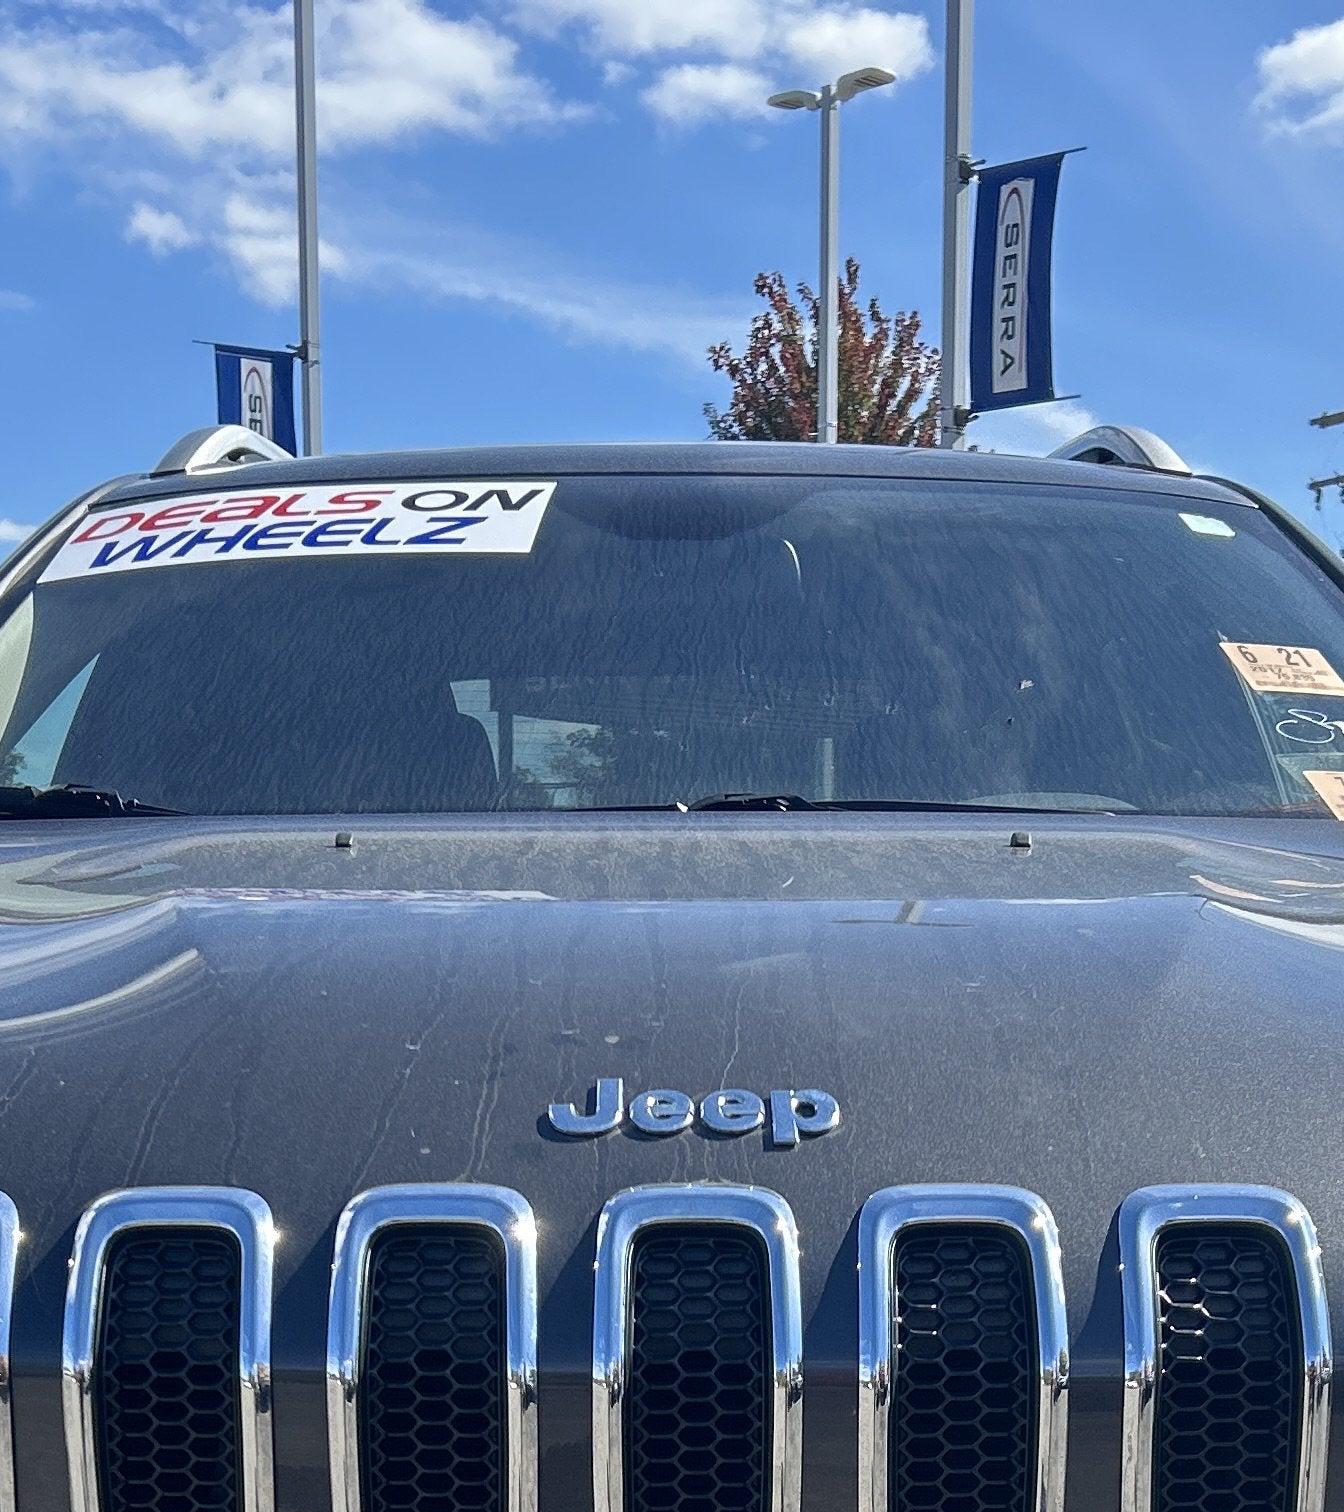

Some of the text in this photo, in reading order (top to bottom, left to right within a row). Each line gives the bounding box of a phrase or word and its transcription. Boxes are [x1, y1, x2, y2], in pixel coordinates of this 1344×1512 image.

[999, 222, 1020, 377] SERRA
[401, 489, 545, 512] ON
[89, 516, 489, 569] WHEELZ
[1236, 645, 1312, 668] 6 21
[547, 1077, 842, 1147] Jeep
